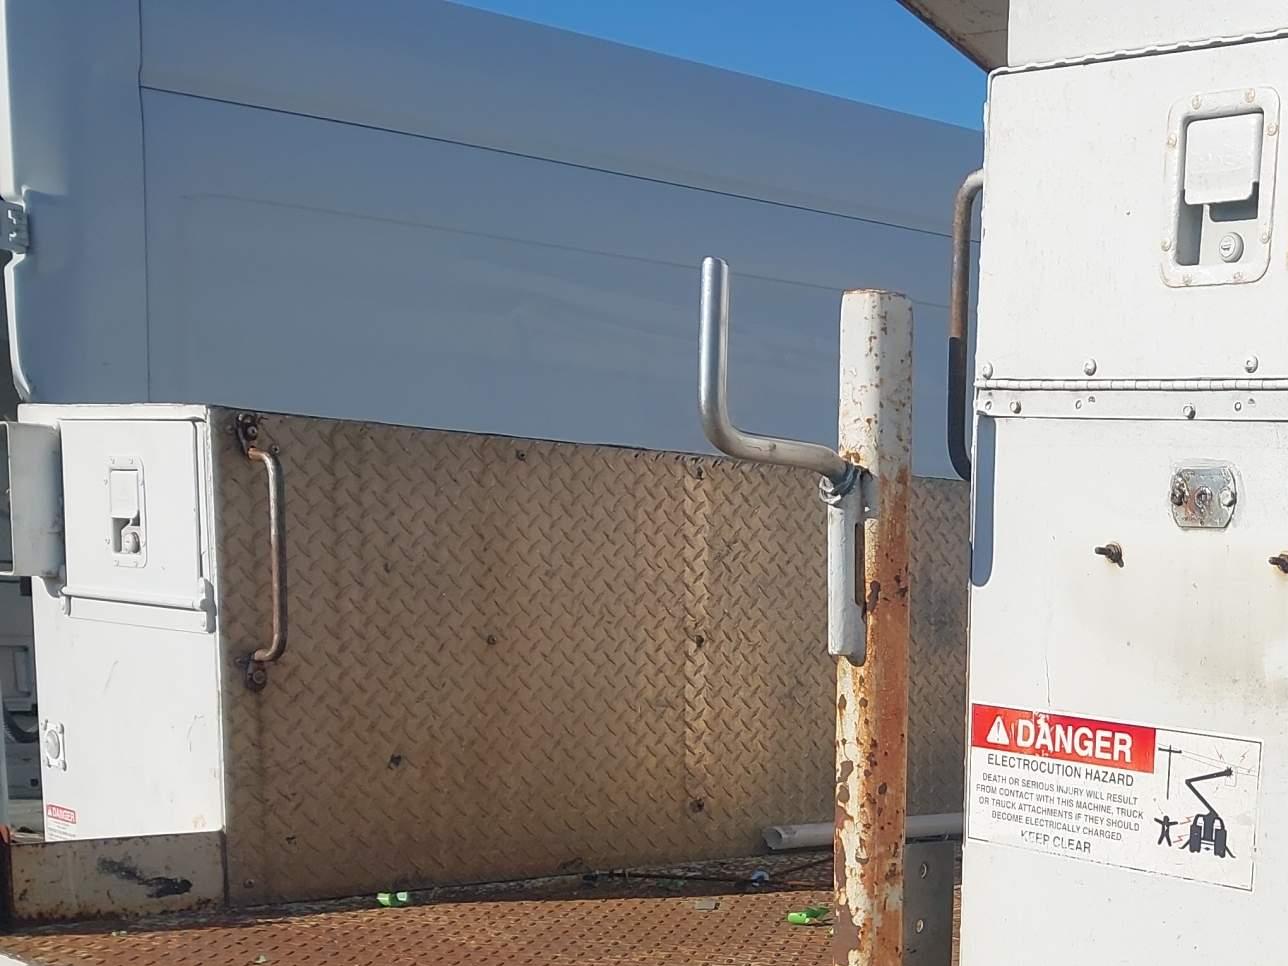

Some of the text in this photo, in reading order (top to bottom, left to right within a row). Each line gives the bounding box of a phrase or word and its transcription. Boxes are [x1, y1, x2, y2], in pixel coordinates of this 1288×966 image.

[1016, 718, 1133, 763] DANGER
[987, 753, 1134, 787] ELECTROCUTION HAZARD
[976, 784, 1144, 820] FROM CONTACT WITH THIS MACHINE, TRUCK
[982, 773, 1138, 805] DEATH OR SERIOUS INJURY WILL RESULT
[979, 796, 1140, 832] OR TRUCK ATTACHMENTS IF THEY SHOULD
[1025, 817, 1081, 832] ELECTRICALLY
[1053, 836, 1091, 853] CLEAR
